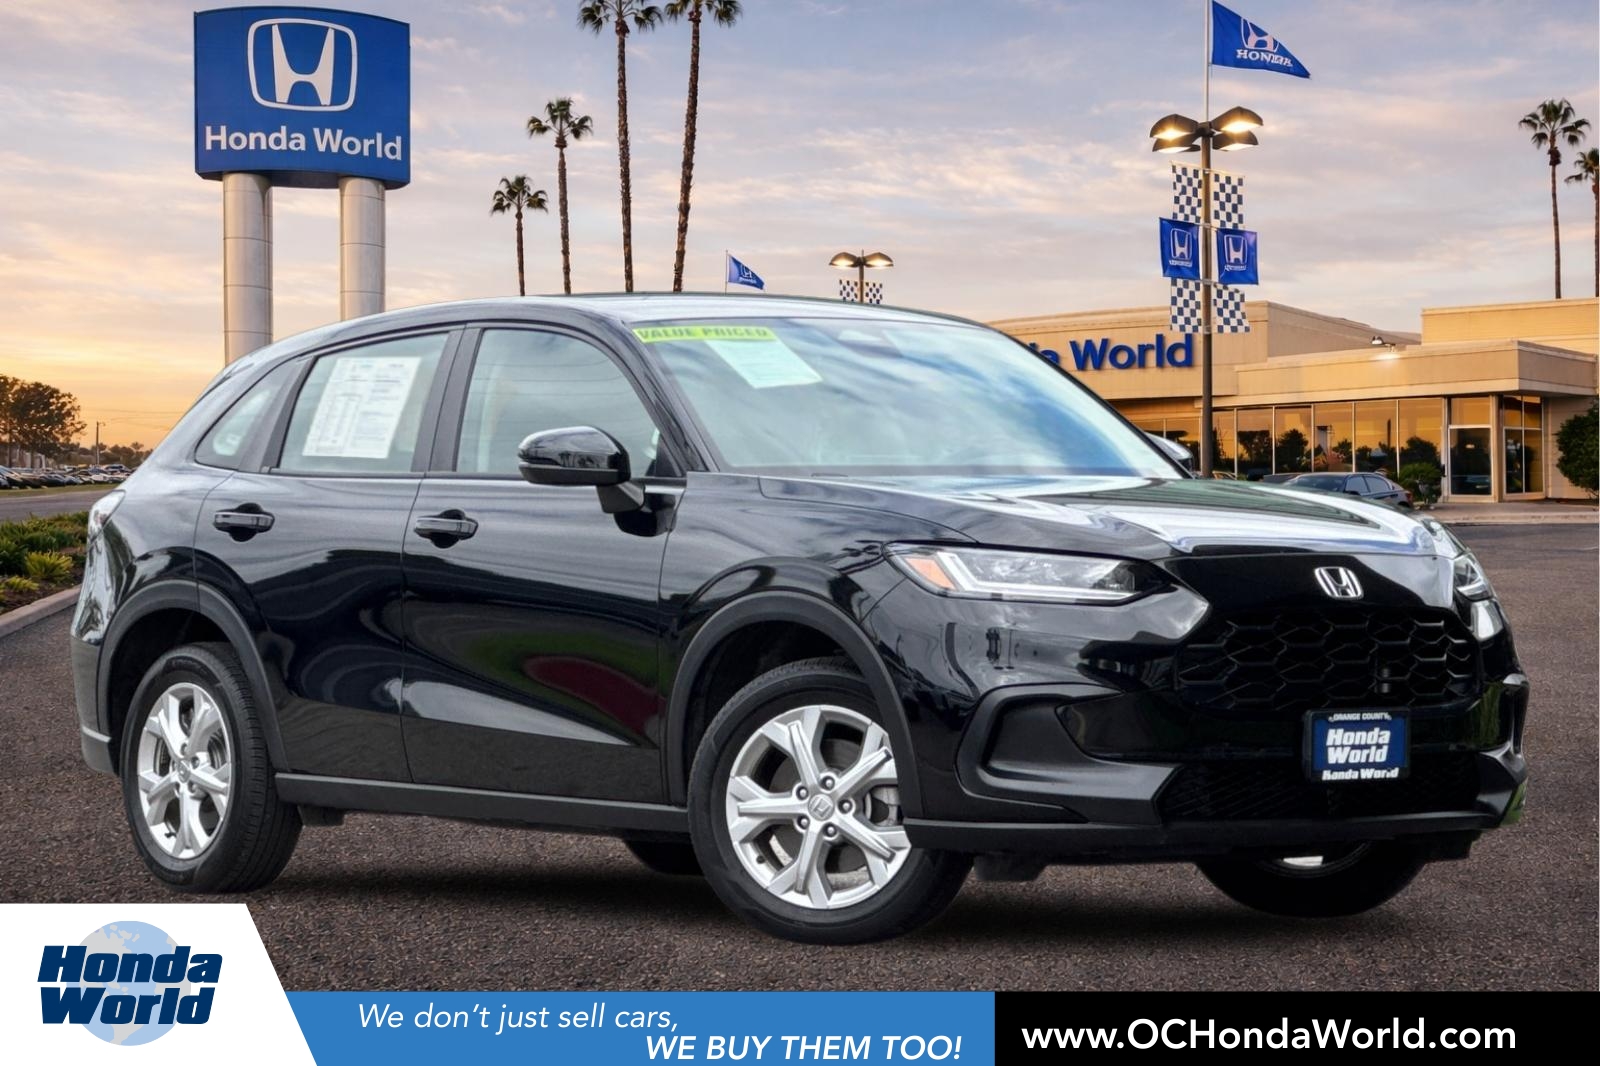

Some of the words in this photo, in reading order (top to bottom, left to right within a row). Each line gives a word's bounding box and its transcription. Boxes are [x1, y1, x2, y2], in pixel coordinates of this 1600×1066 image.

[205, 125, 306, 151] Honda
[313, 127, 402, 161] World
[637, 327, 692, 340] VALUE
[701, 326, 768, 338] PRICED
[1069, 333, 1194, 372] World
[1325, 727, 1391, 746] Honda
[1327, 745, 1388, 764] World
